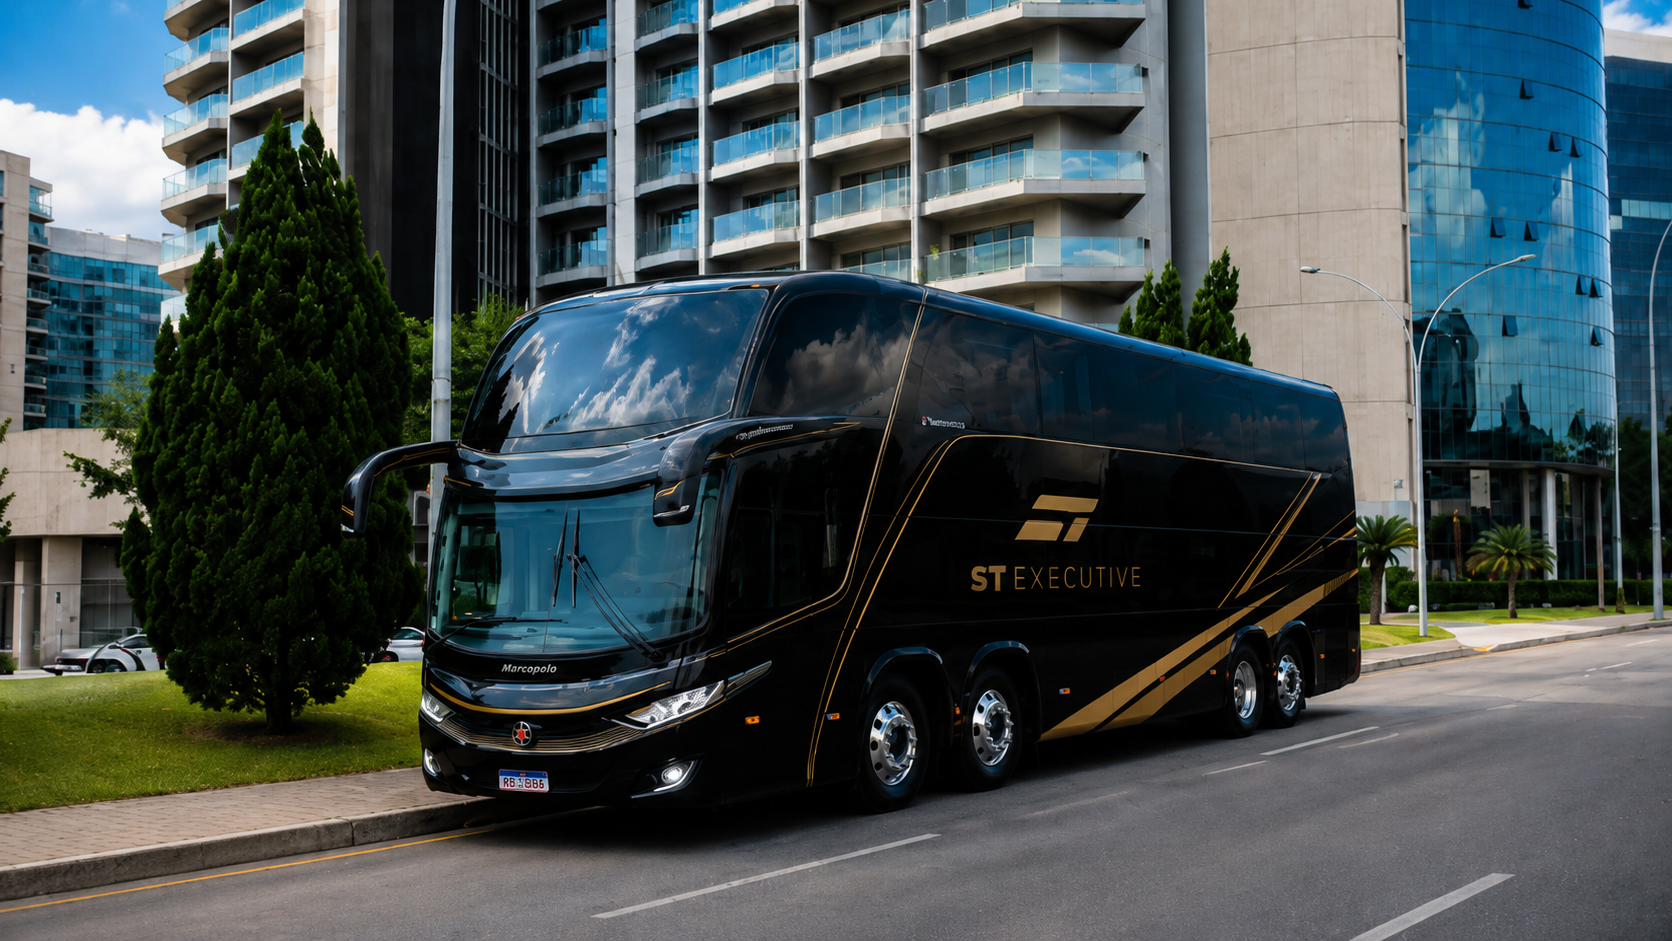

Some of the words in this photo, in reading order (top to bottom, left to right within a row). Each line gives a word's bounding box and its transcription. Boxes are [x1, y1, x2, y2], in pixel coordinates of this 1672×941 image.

[970, 565, 1007, 592] ST
[1014, 565, 1141, 590] EXECUTIVE
[501, 663, 558, 676] Marcopolo
